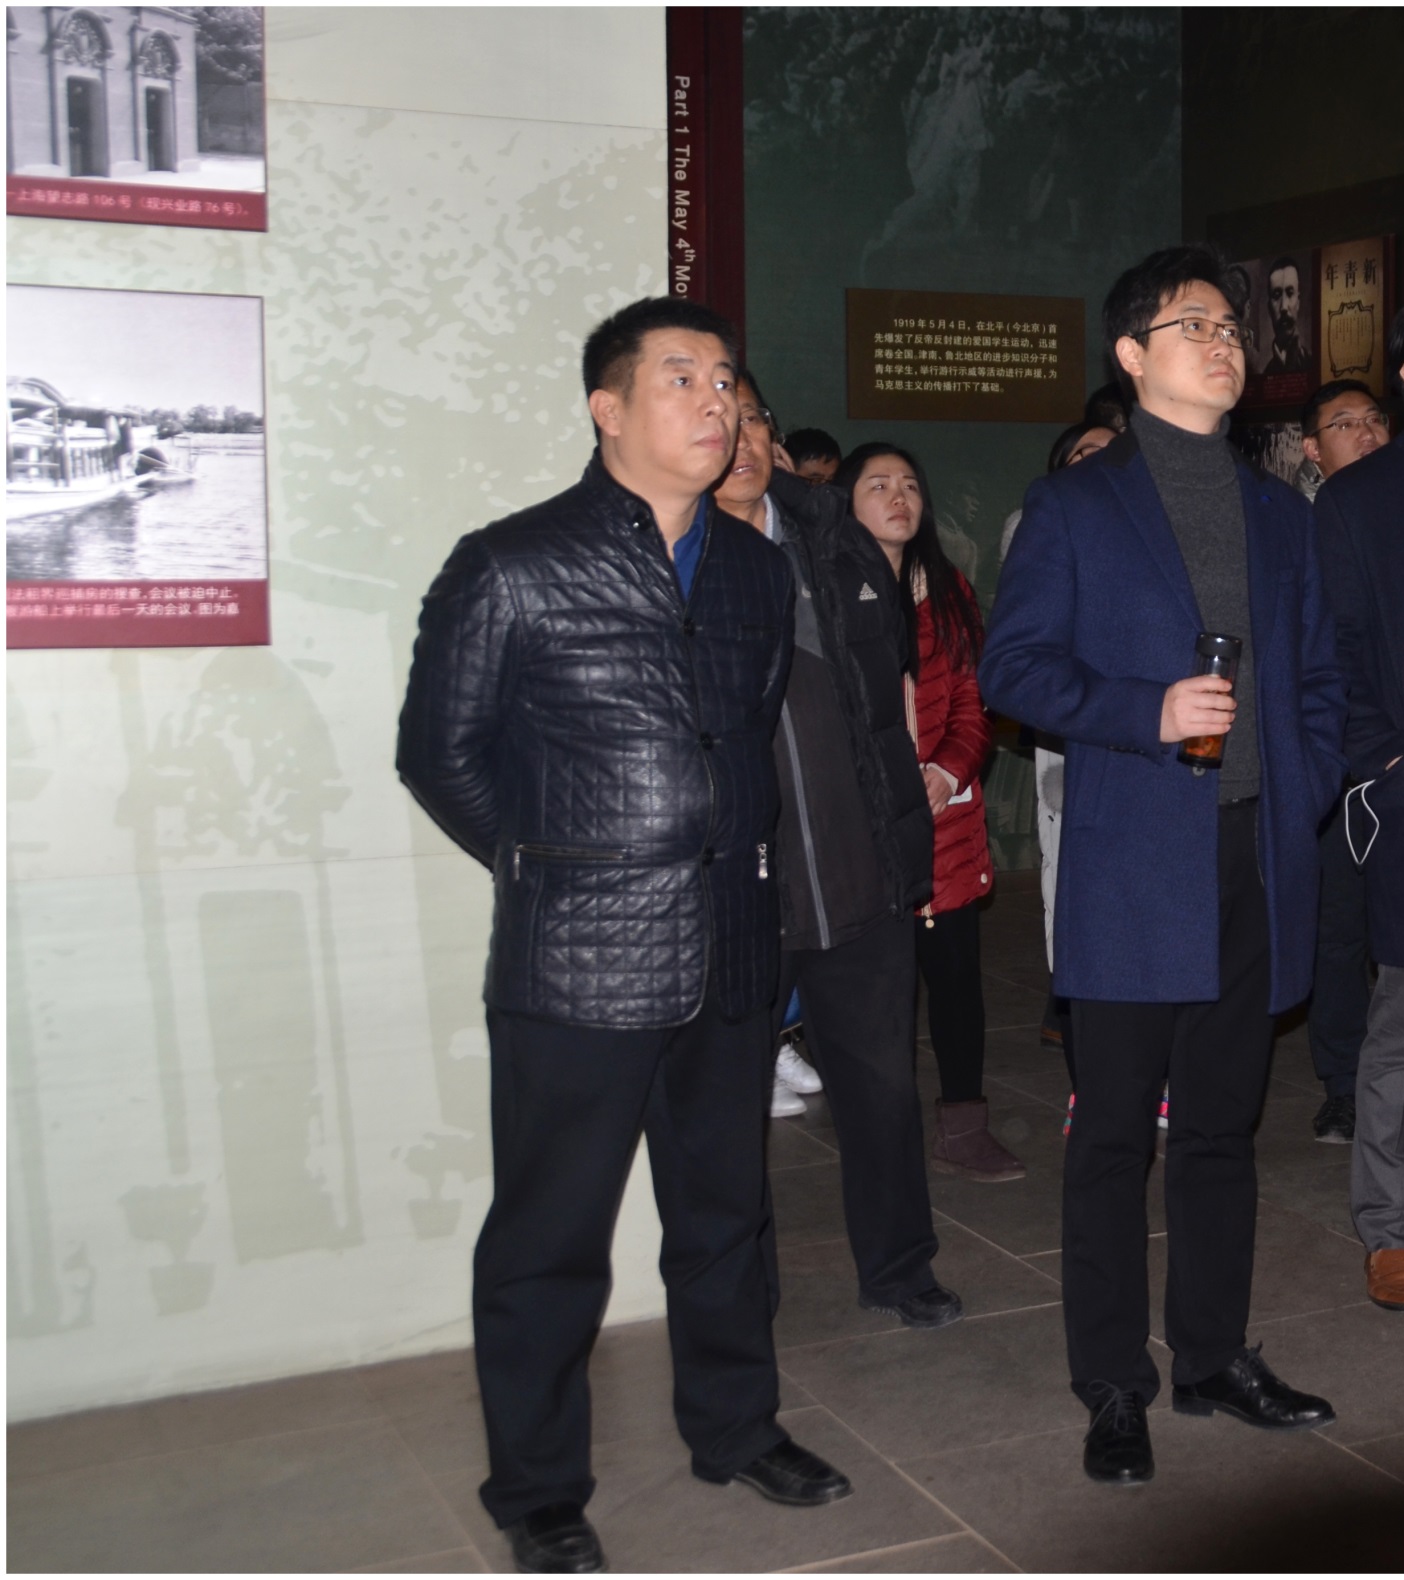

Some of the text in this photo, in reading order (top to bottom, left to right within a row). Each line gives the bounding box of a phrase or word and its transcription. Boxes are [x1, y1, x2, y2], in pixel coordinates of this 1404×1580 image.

[674, 75, 691, 117] Part
[674, 145, 691, 181] The
[672, 189, 691, 230] May
[674, 238, 697, 262] 4th
[874, 380, 1004, 393] 马克思主义的传播打下了基础。
